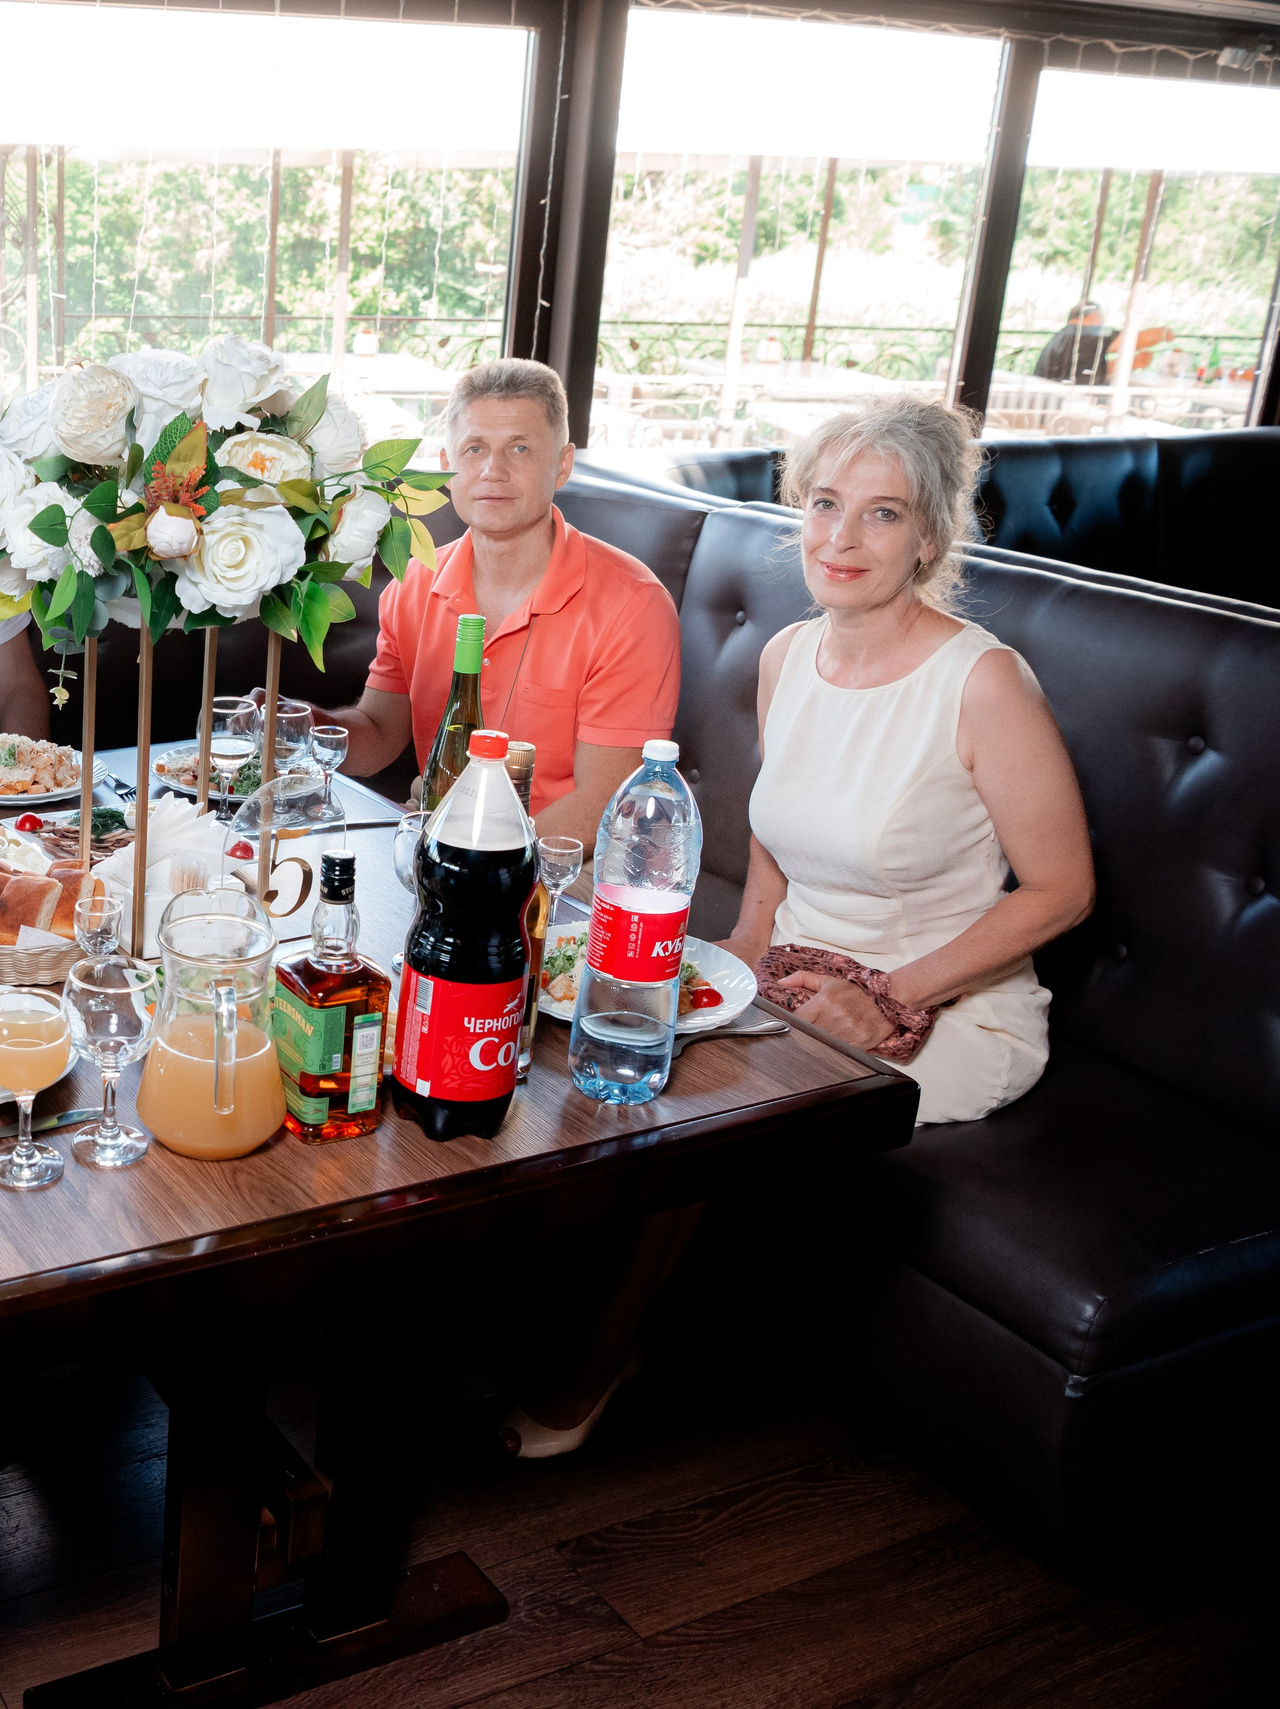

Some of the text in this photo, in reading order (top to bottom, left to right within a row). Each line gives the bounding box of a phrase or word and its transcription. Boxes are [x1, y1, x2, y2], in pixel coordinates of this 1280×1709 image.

[263, 826, 313, 918] 5
[651, 937, 682, 957] КУБ
[274, 996, 314, 1037] TEERSMAN
